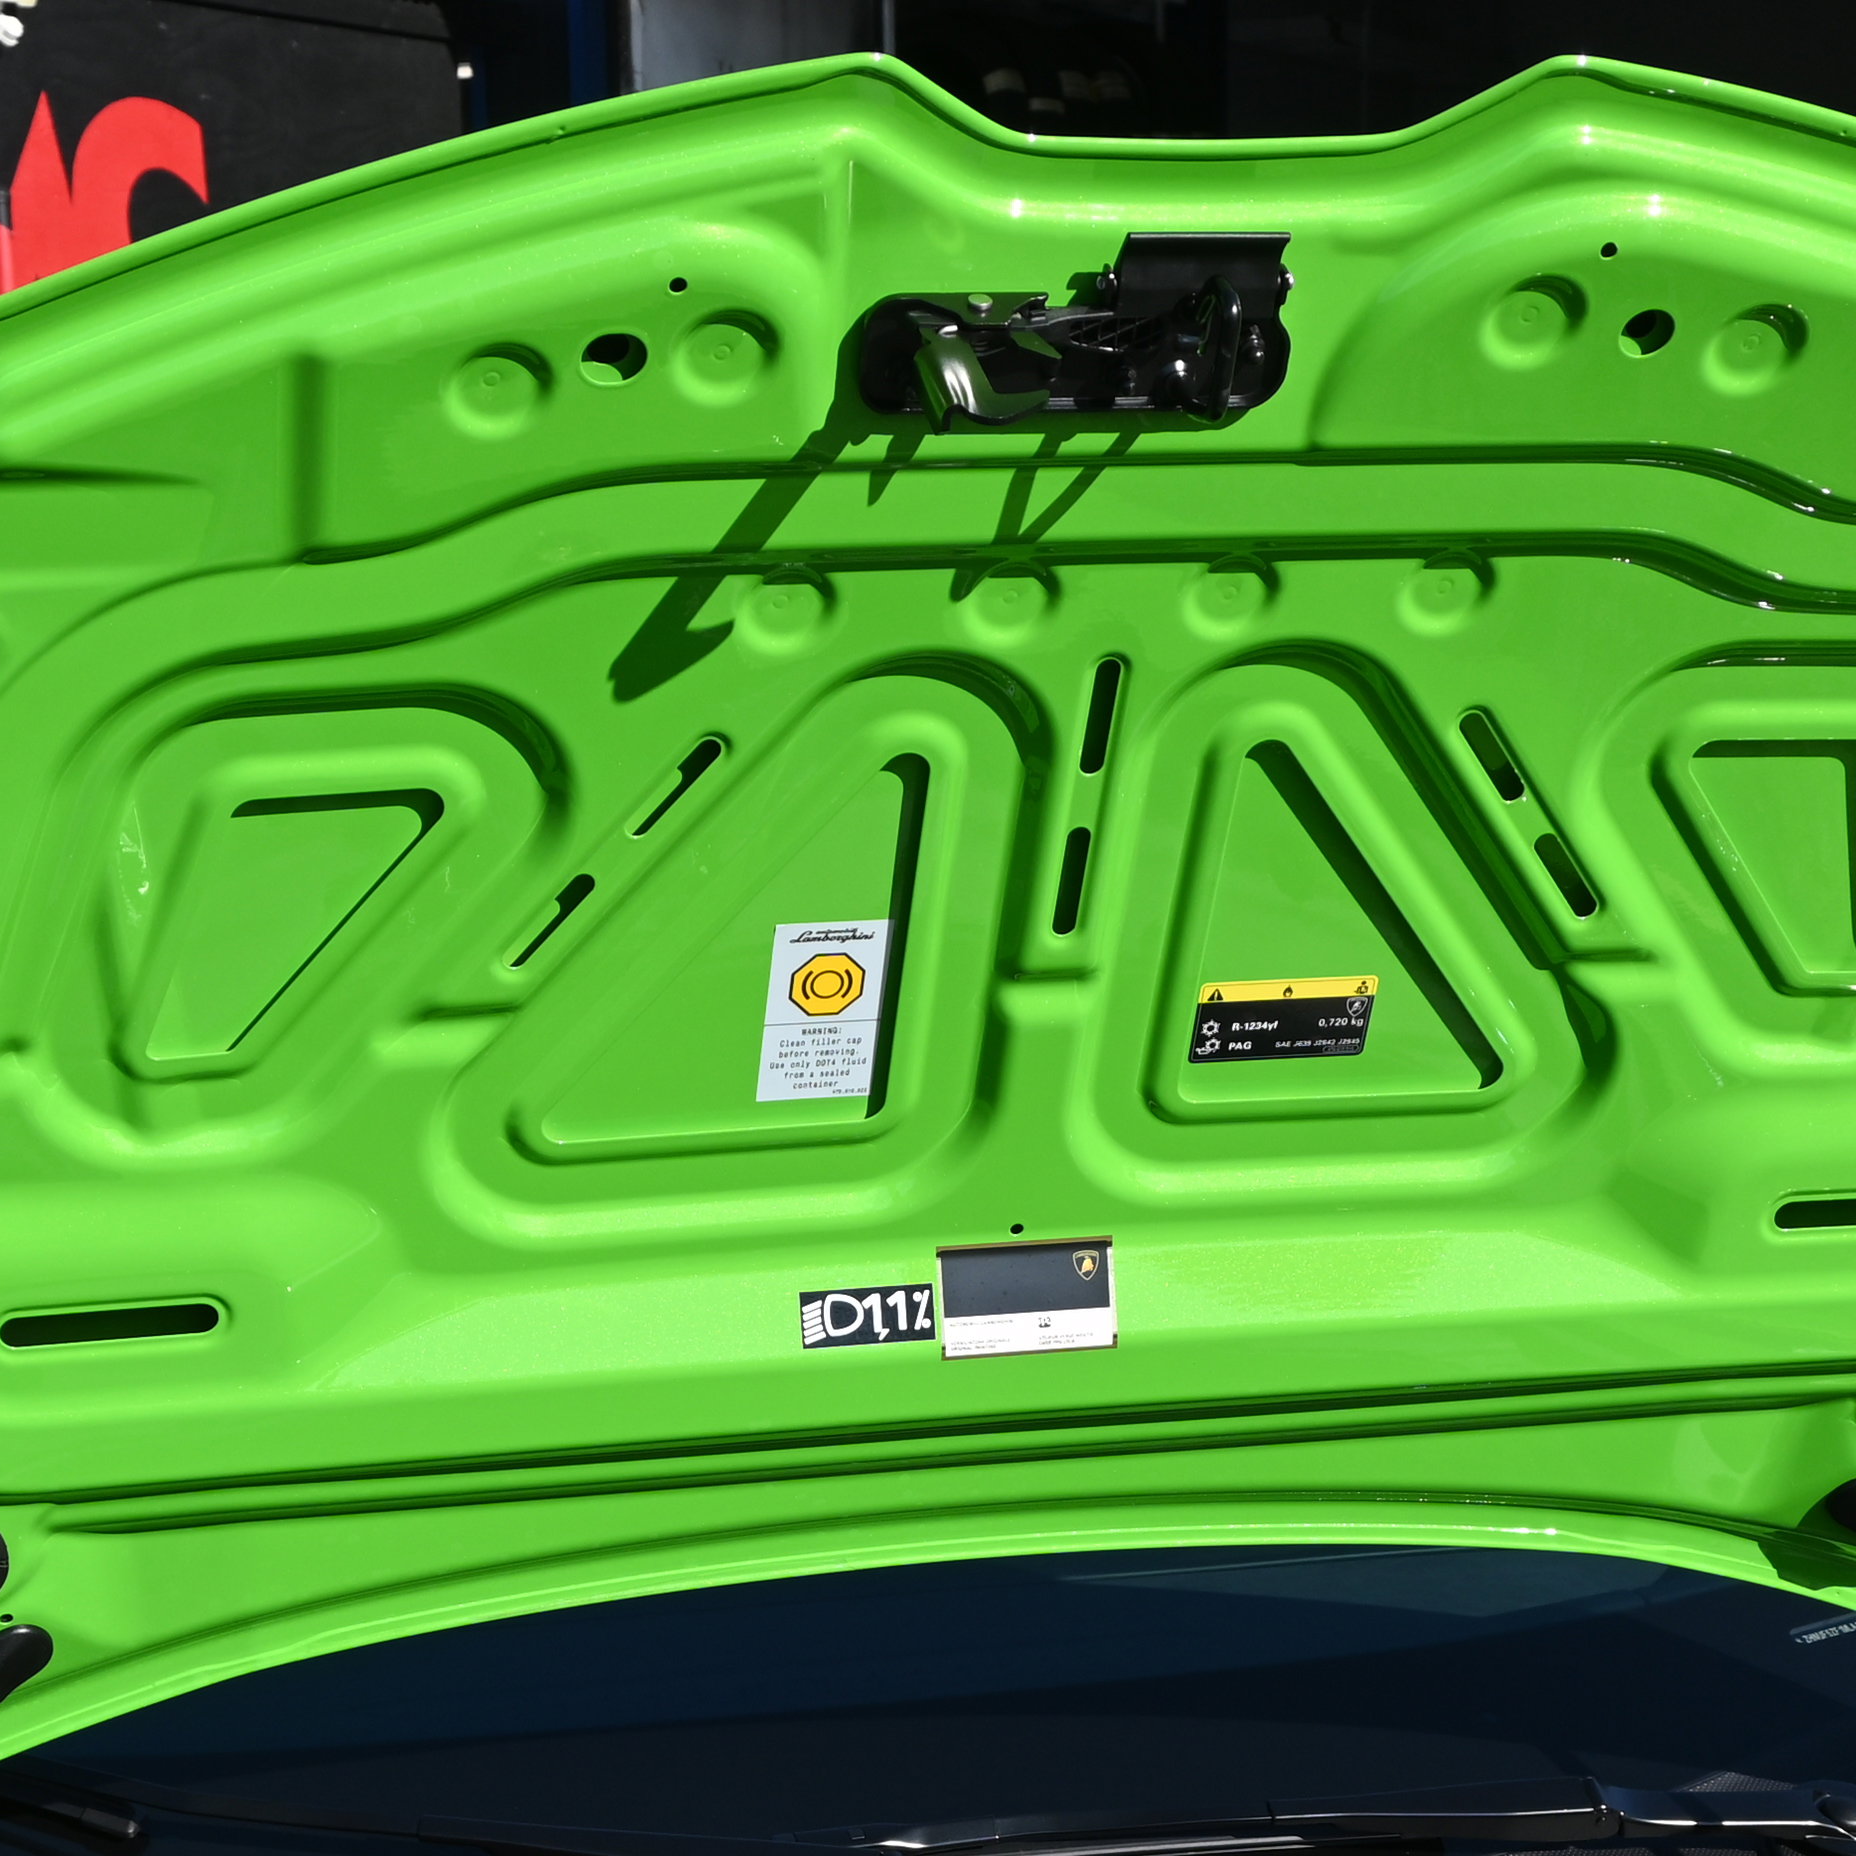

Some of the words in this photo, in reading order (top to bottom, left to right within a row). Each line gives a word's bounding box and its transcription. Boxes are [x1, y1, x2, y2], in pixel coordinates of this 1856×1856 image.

[789, 930, 875, 943] Lamborghini
[1231, 1020, 1279, 1032] R-1234yf
[1318, 1018, 1348, 1028] 0,720
[1351, 1017, 1364, 1027] kg
[801, 1027, 842, 1036] WARNING:
[779, 1039, 805, 1048] Clean
[811, 1037, 842, 1046] filler
[846, 1037, 862, 1045] cap
[1228, 1041, 1252, 1050] PAG
[1275, 1040, 1291, 1048] SAE
[778, 1050, 809, 1058] before
[790, 1060, 810, 1069] only
[815, 1059, 836, 1067] DOT4
[842, 1057, 867, 1066] fluid
[784, 1071, 805, 1079] from
[819, 1068, 850, 1078] sealed
[792, 1080, 838, 1089] container
